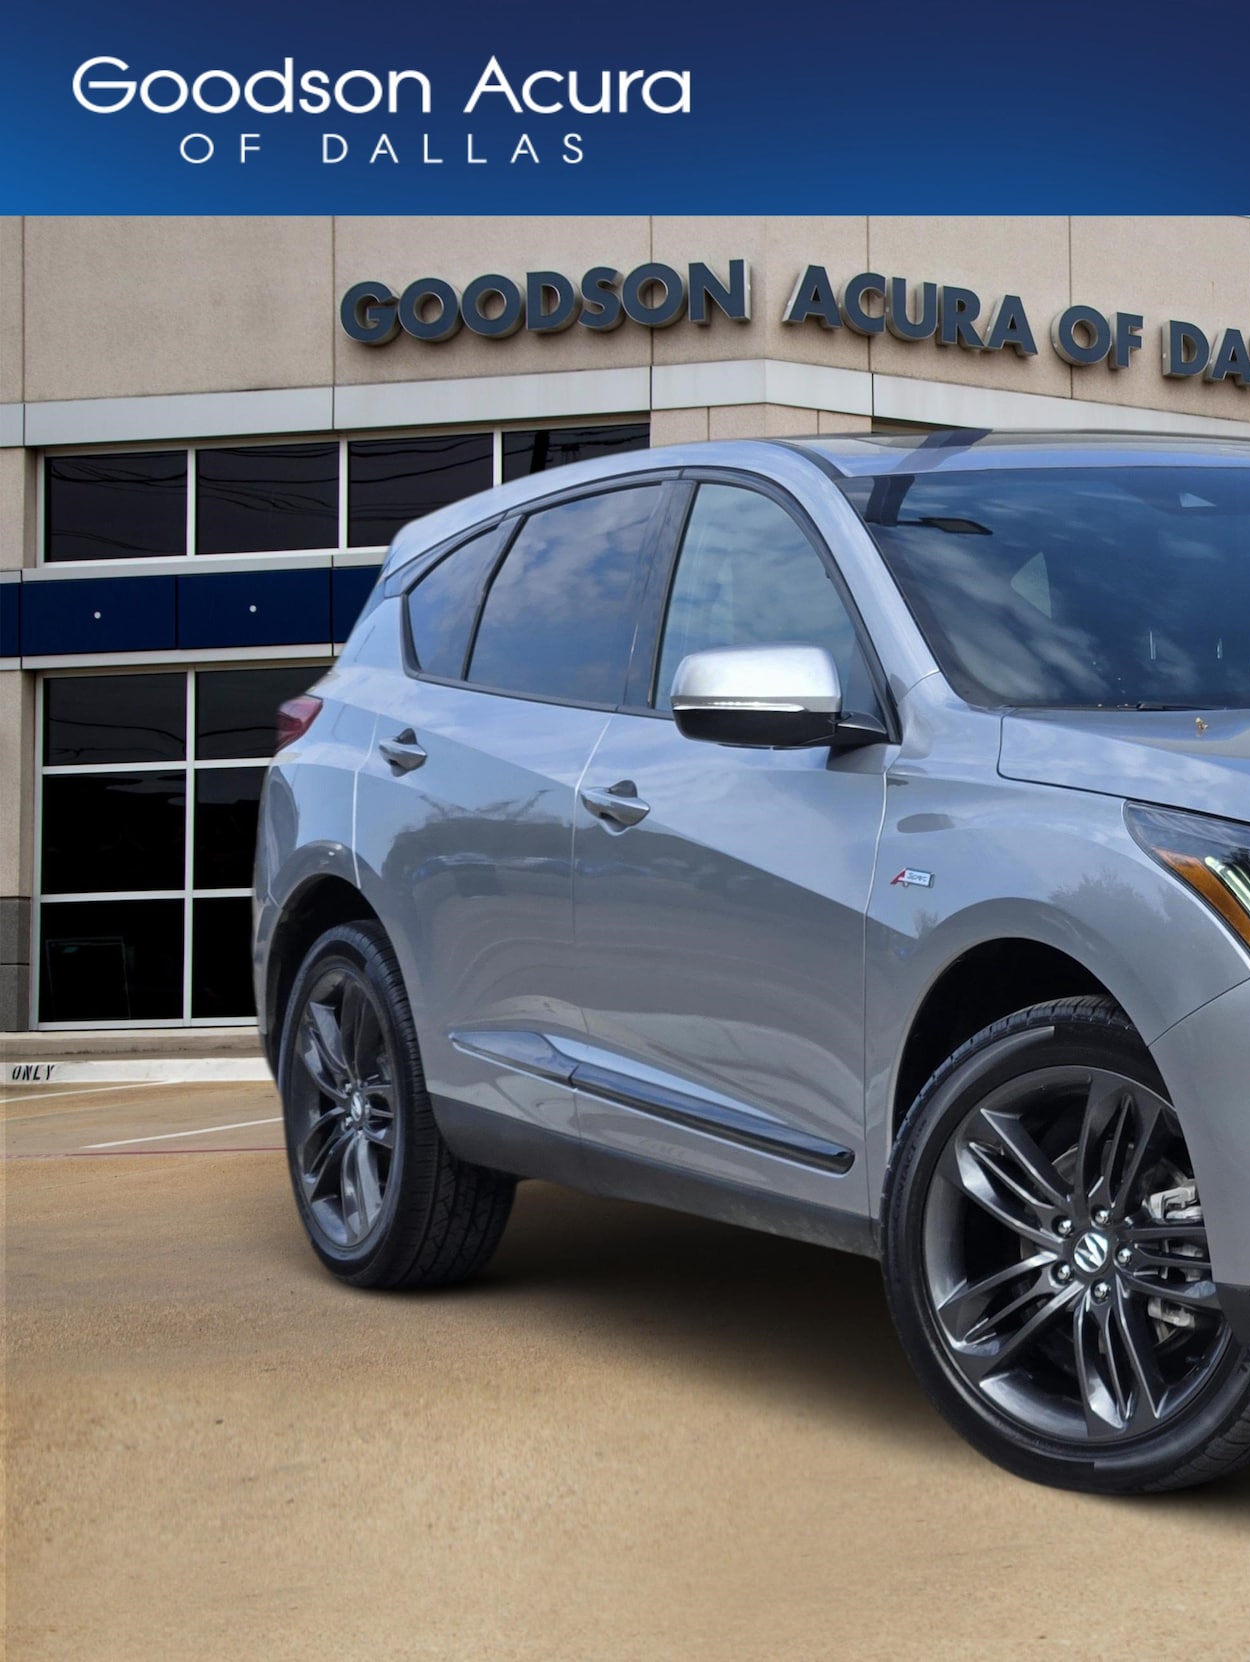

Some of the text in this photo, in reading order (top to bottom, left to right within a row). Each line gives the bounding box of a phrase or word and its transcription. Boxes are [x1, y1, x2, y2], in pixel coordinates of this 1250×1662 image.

[339, 258, 752, 346] GOODSON
[781, 264, 1039, 357] ACURA
[1051, 304, 1145, 370] OF
[11, 1064, 56, 1081] ONLY
